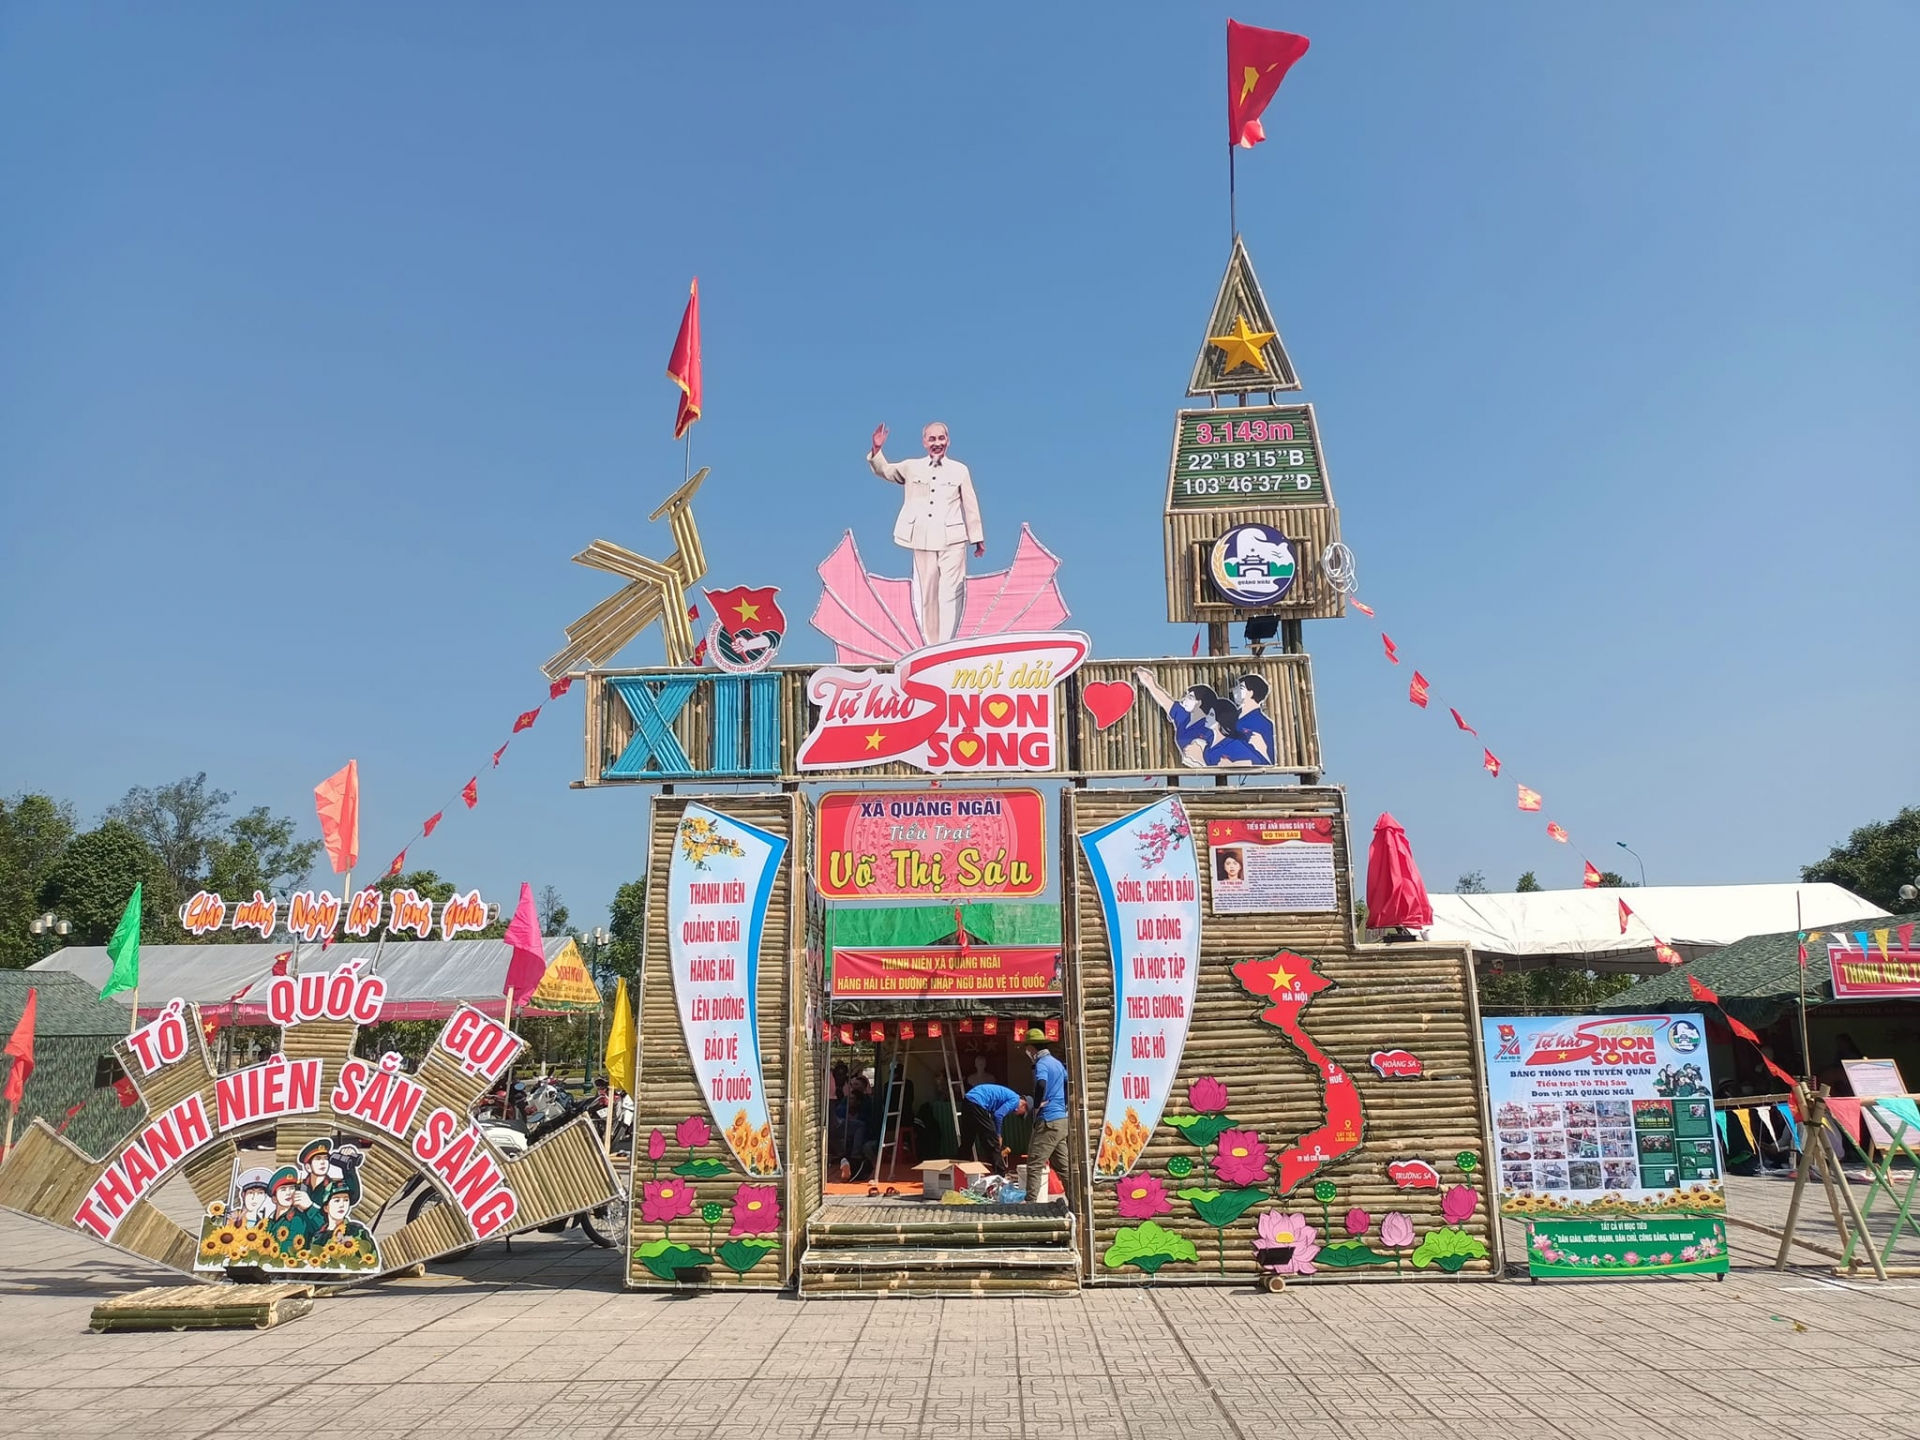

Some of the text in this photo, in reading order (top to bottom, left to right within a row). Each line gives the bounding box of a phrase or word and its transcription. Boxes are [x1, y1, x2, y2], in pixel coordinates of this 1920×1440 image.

[1197, 420, 1293, 444] 3.143m
[951, 660, 1055, 694] một dải
[813, 676, 915, 724] Tự hào
[948, 693, 1048, 728] NON
[927, 726, 1050, 767] SÔNG
[861, 797, 1001, 818] XÃ QUẢNG NGÃI
[890, 822, 971, 842] Tiểu Trại
[829, 847, 1033, 893] Võ Thị Sáu
[690, 878, 745, 904] THANH NIÊN
[1117, 872, 1194, 904] SỐNG, CHIẾN ĐẤU
[186, 892, 485, 937] Chào mừng Ngày hội Tòng quân
[683, 914, 740, 945] QUẢNG NGÃI
[1137, 914, 1181, 945] LAO ĐỘNG
[690, 954, 734, 982] HĂNG HÁI
[881, 958, 909, 969] THANH
[911, 955, 932, 970] NIÊN
[935, 955, 946, 969] XÃ
[980, 955, 1001, 968] NGÃI
[1133, 952, 1185, 984] VÀ HỌC TẬP
[1842, 963, 1880, 984] THANH
[1882, 957, 1910, 984] NIÊN
[837, 971, 1045, 992] HĂNG HÁI LÊN ĐƯỜNG NHẬP NGŨ BẢO VỆ TỔ QUỐC
[692, 993, 744, 1021] LÊN ĐƯỜNG
[1127, 994, 1184, 1018] THEO GƯƠNG
[1282, 991, 1308, 1003] HÀ NỘI
[130, 961, 518, 1077] TỔ QUỐC GỌI
[705, 1030, 737, 1065] BẢO VỆ
[1131, 1032, 1150, 1059] BÁC
[1591, 1050, 1656, 1065] SÔNG
[1600, 1037, 1654, 1050] NON
[1382, 1060, 1406, 1068] HOÀNG
[1539, 1069, 1571, 1077] THÔNG
[1626, 1068, 1651, 1077] QUÂN
[712, 1069, 751, 1103] TỔ QUỐC
[1122, 1072, 1150, 1104] VĨ ĐẠI
[75, 1053, 515, 1238] THANH NIÊN SẴN SÀNG
